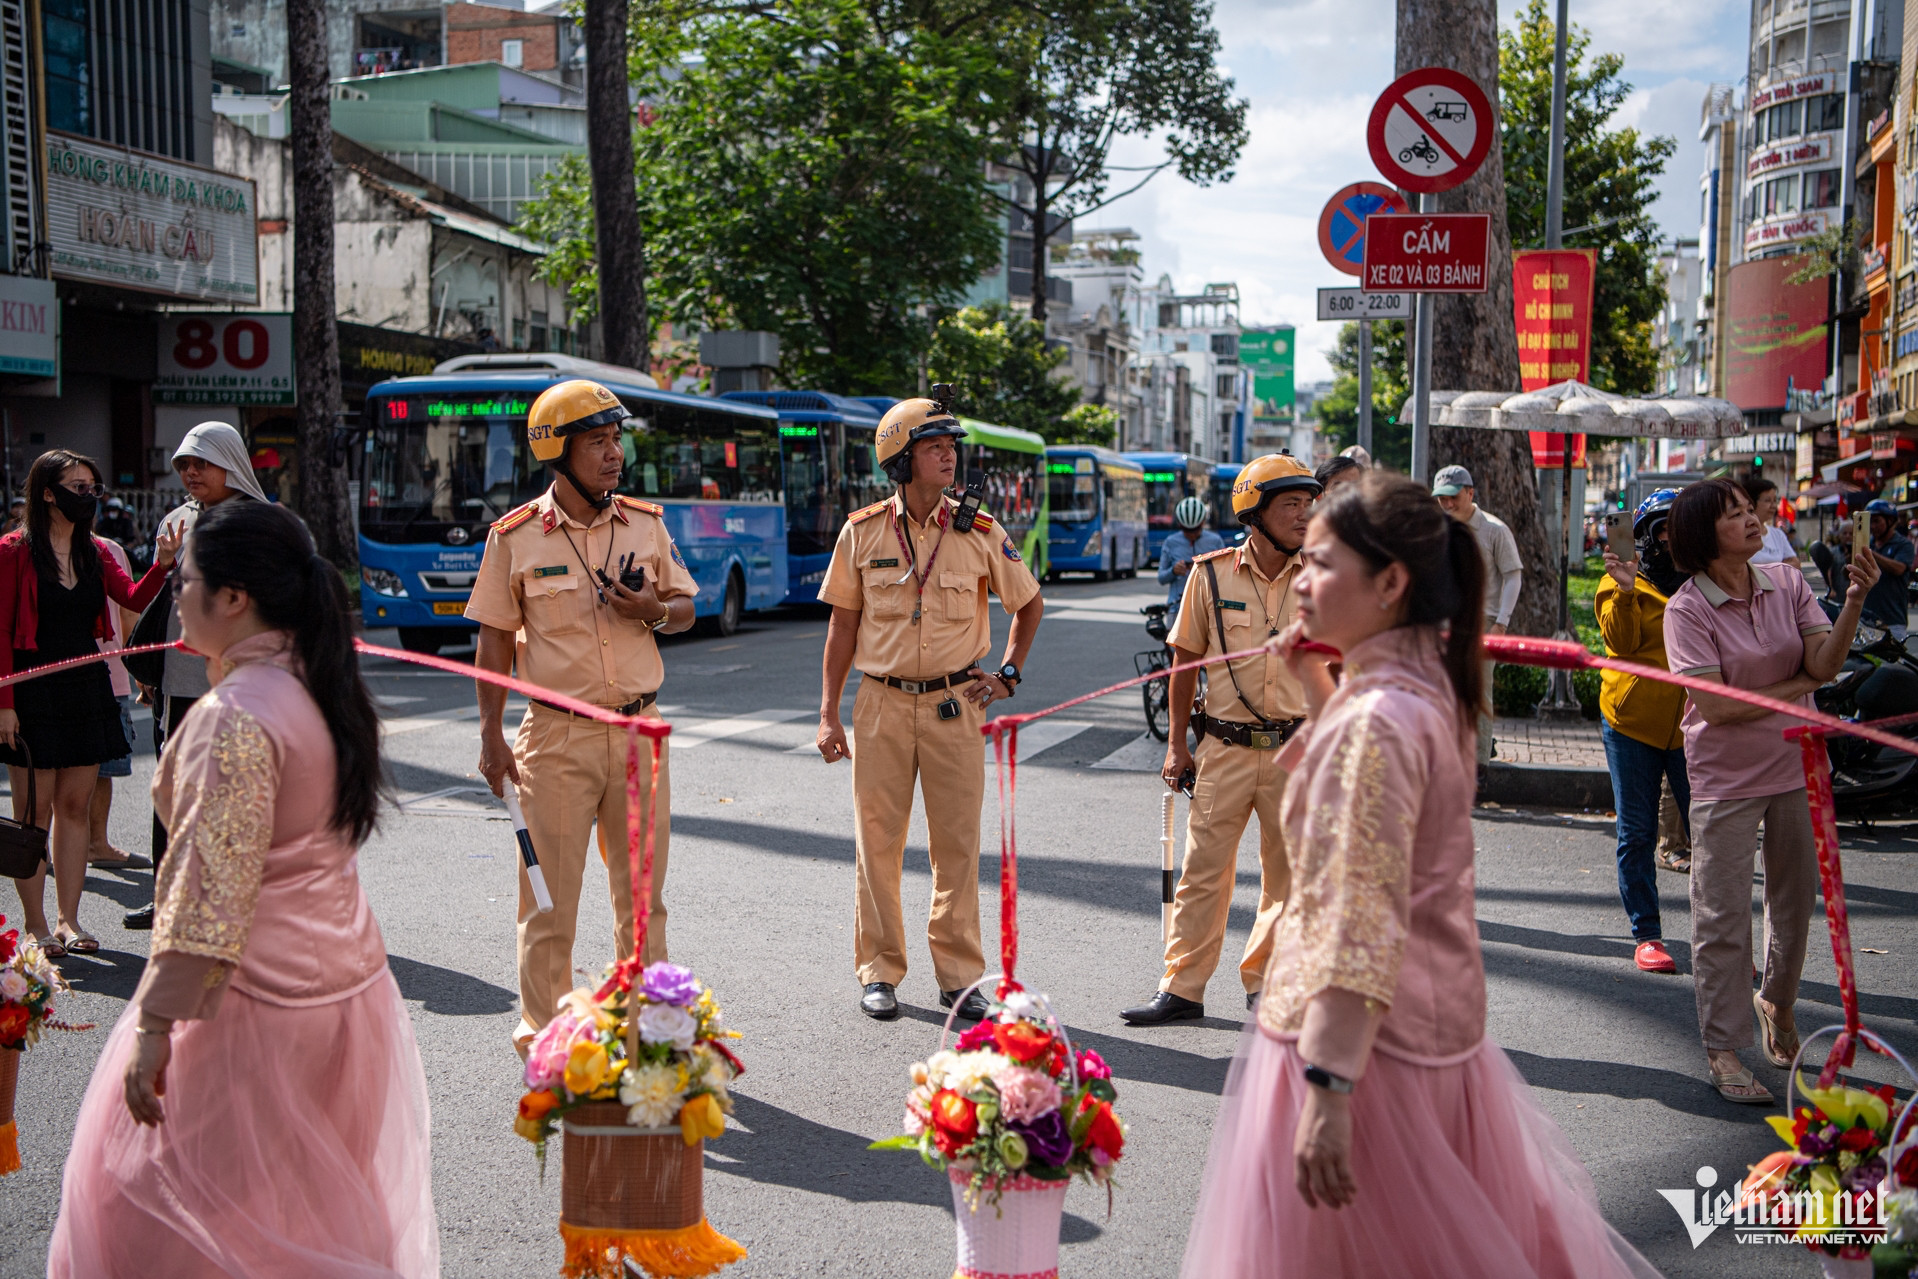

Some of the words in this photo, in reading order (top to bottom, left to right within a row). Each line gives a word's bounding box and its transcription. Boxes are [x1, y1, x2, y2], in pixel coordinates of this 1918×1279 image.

[113, 160, 169, 196] KHÁM
[202, 184, 247, 214] KHOA
[78, 198, 155, 254] HOÀN
[1403, 221, 1451, 254] CẤM
[1370, 265, 1387, 285] XE
[1389, 265, 1403, 285] 02
[1406, 259, 1424, 285] VÀ
[1426, 265, 1441, 285] 03
[1444, 259, 1481, 285] BÁNH
[1, 300, 47, 334] KIM
[1329, 296, 1354, 311] 6:00
[1369, 295, 1400, 310] 22:00
[1552, 303, 1573, 320] MINH
[173, 318, 269, 371] 80
[387, 401, 408, 419] 10
[876, 421, 903, 446] CSGT
